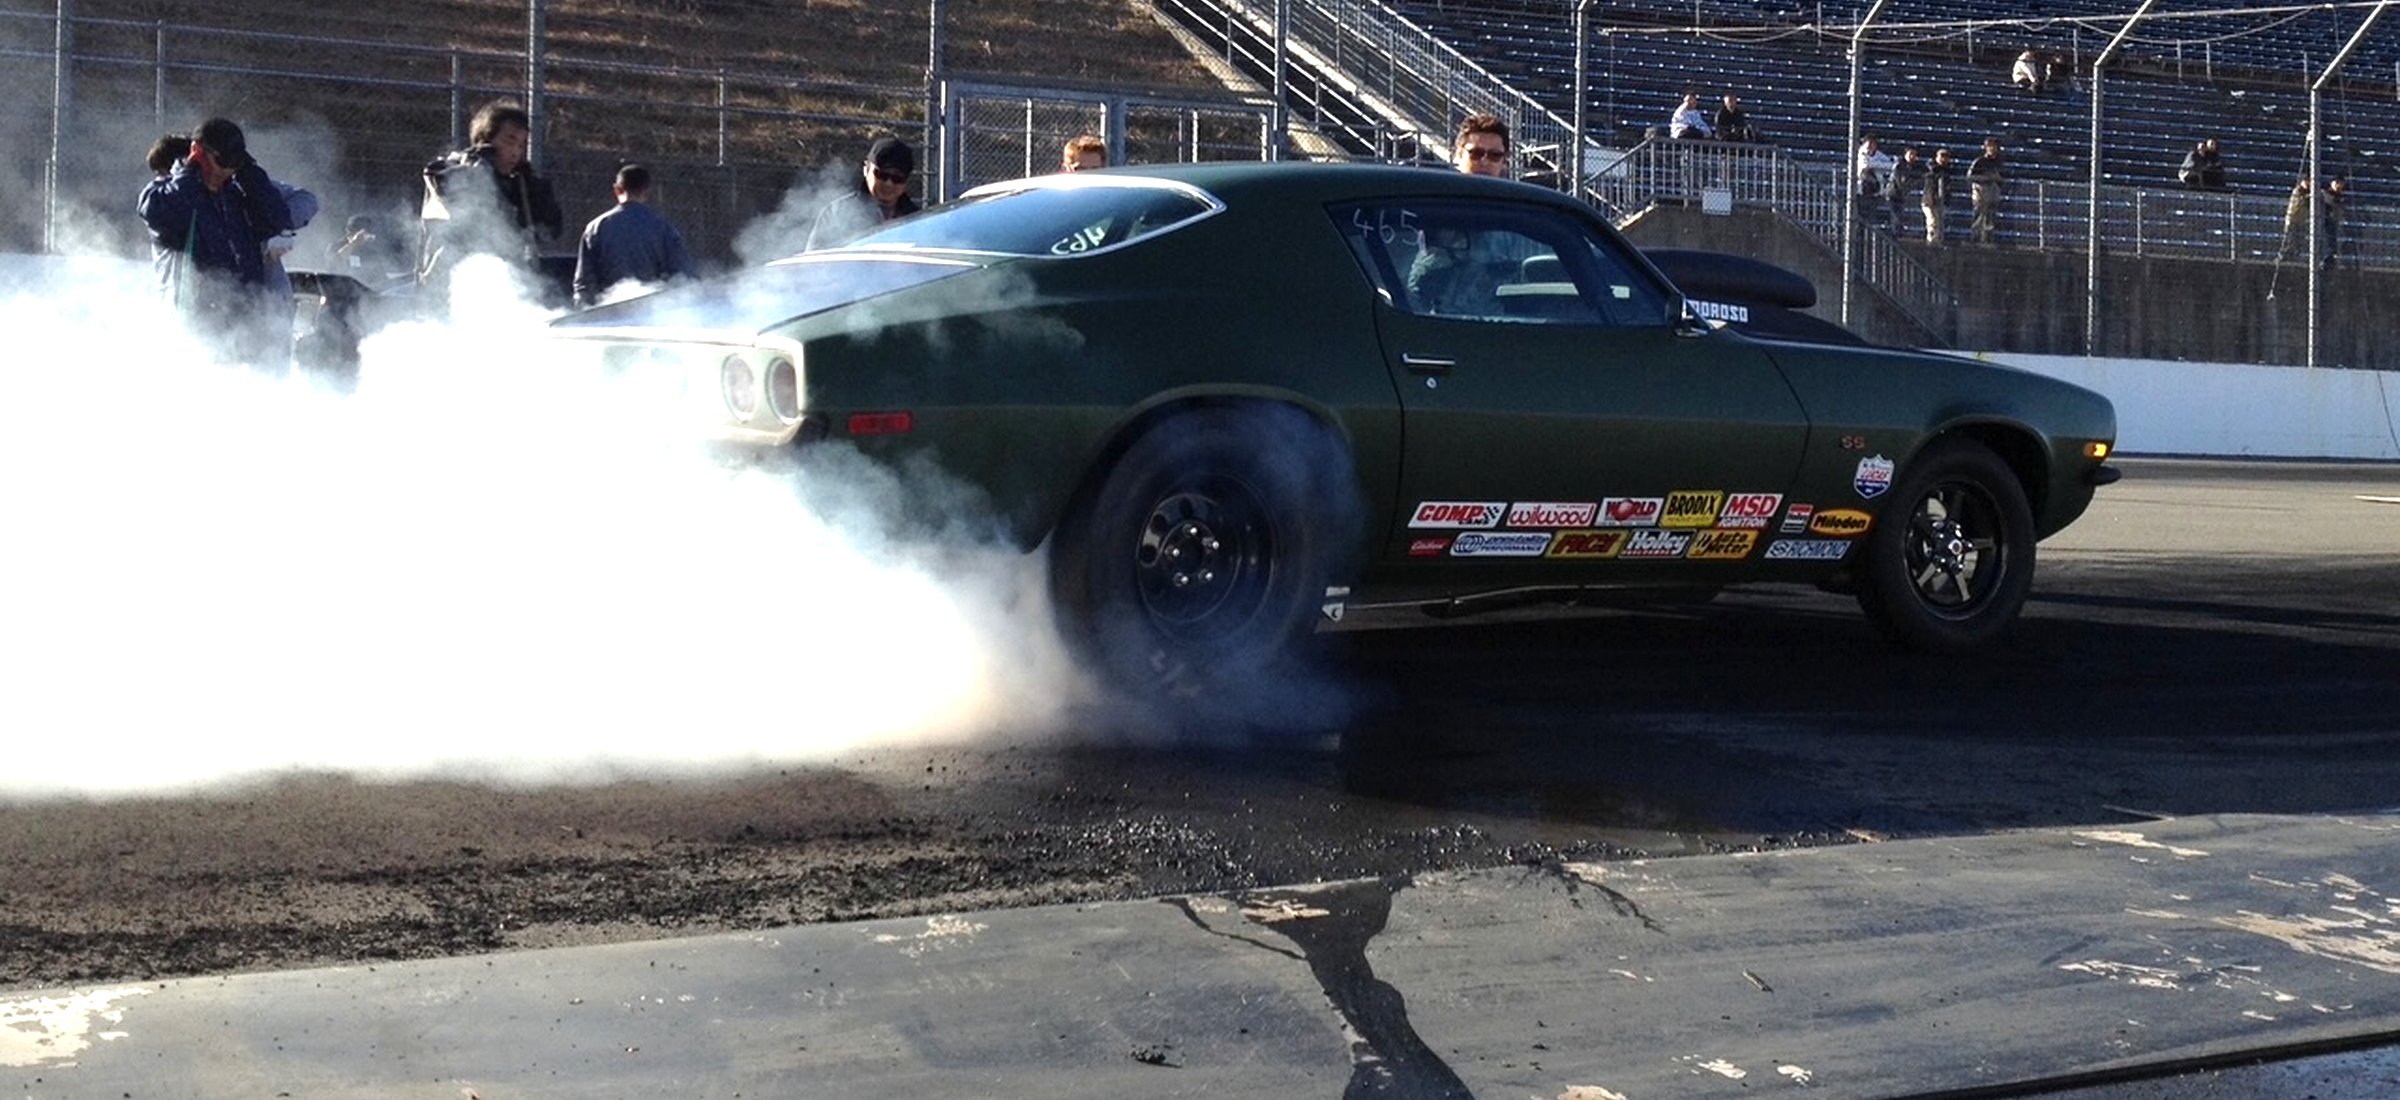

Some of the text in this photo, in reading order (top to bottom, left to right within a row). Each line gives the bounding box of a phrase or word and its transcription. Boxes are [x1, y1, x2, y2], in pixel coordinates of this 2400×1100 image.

[1352, 207, 1420, 246] 465
[1417, 505, 1484, 521] COMP
[1509, 504, 1595, 525] wilwood
[1605, 499, 1657, 521] WORLD
[1667, 495, 1719, 516] BRODIX
[1724, 495, 1777, 516] MSD
[1627, 530, 1690, 555] Holley
